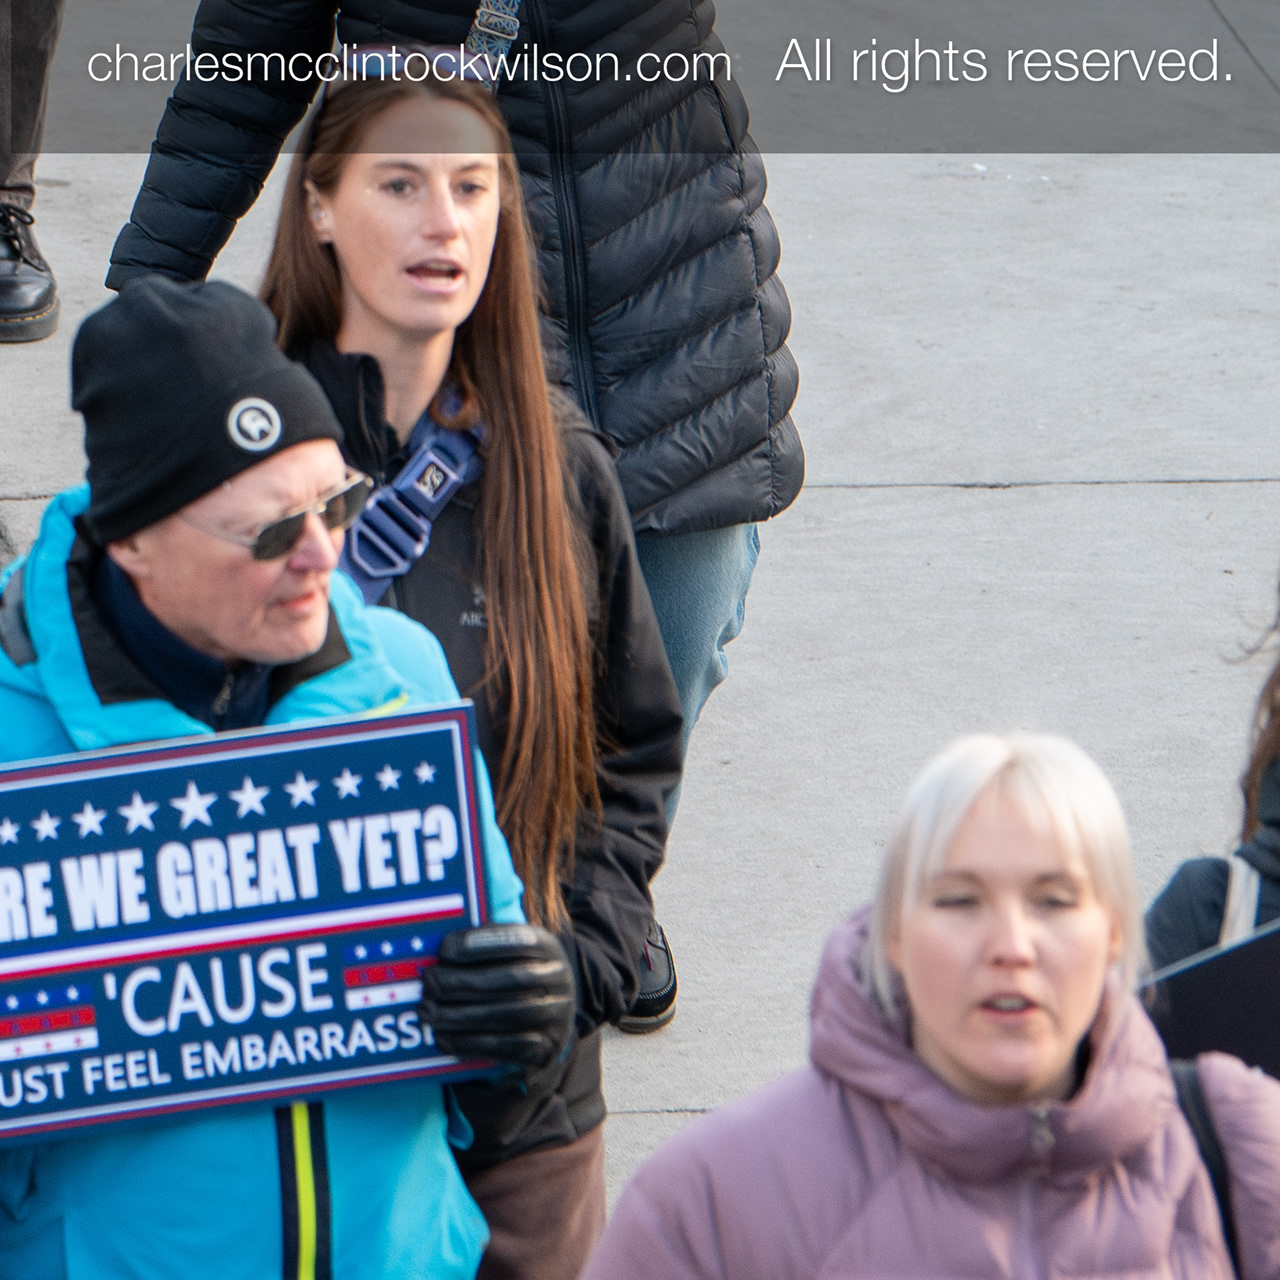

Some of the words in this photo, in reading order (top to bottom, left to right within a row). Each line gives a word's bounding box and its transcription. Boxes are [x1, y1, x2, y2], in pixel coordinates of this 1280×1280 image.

[60, 848, 150, 932] WE
[156, 823, 321, 919] GREAT
[328, 805, 459, 893] YET?
[103, 942, 334, 1038] 'CAUSE
[82, 1048, 172, 1094] FEEL
